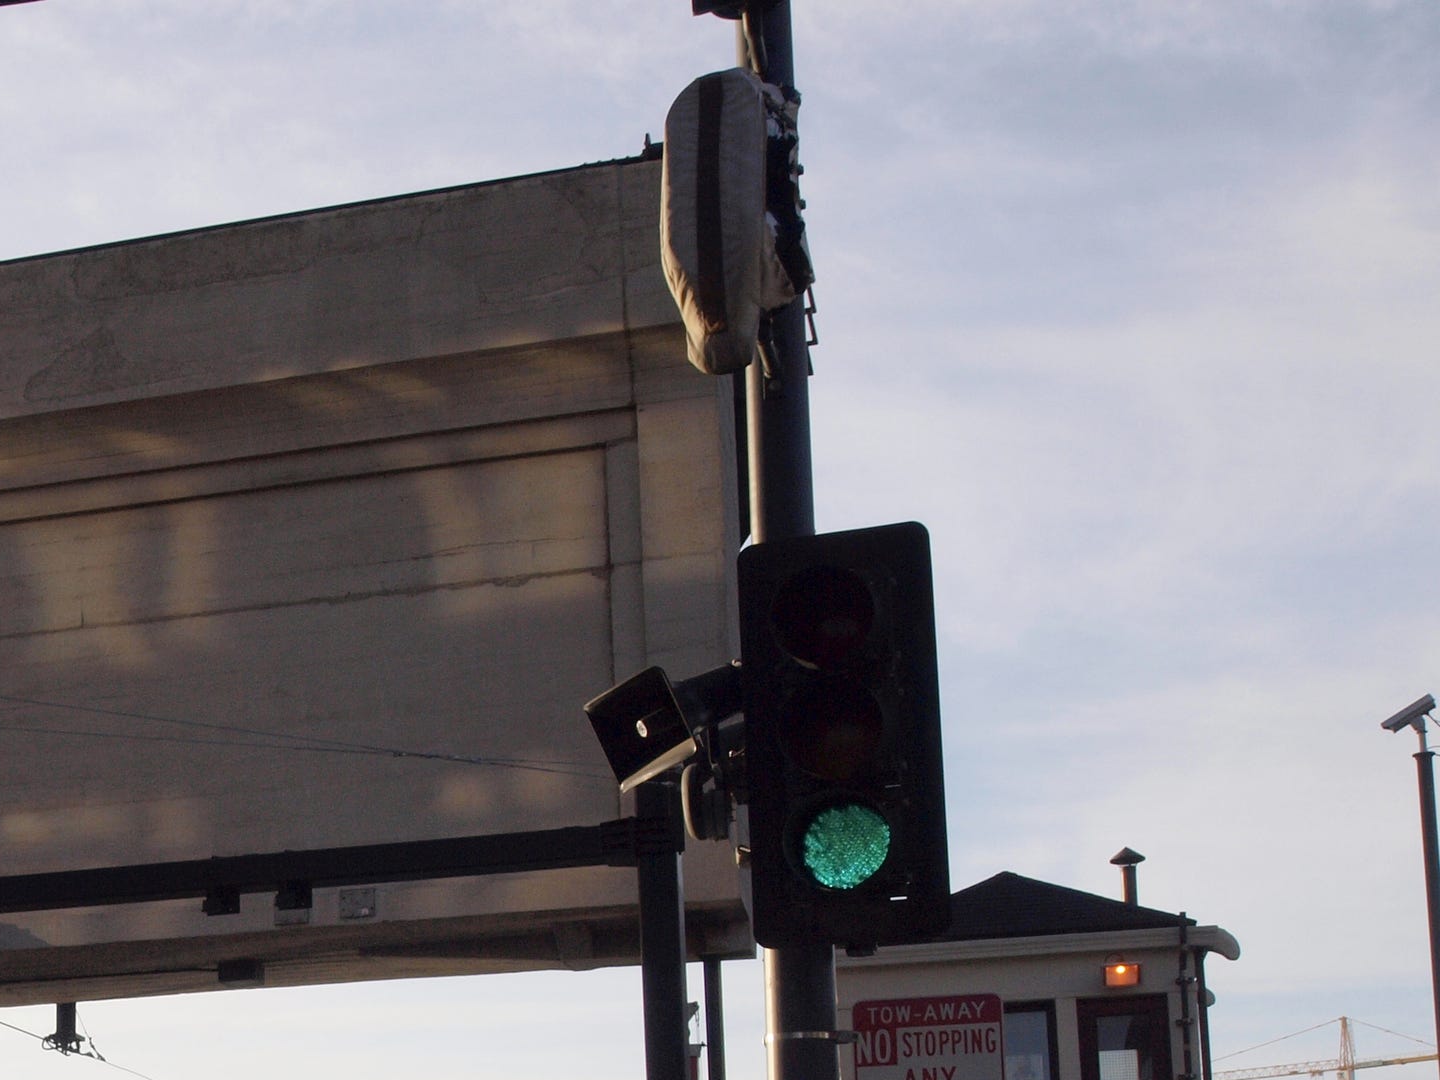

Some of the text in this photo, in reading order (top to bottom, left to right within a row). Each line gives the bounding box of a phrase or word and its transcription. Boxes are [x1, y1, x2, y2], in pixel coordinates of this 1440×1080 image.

[867, 1001, 986, 1025] TOW-AWAY
[856, 1028, 996, 1064] NO STOPPING
